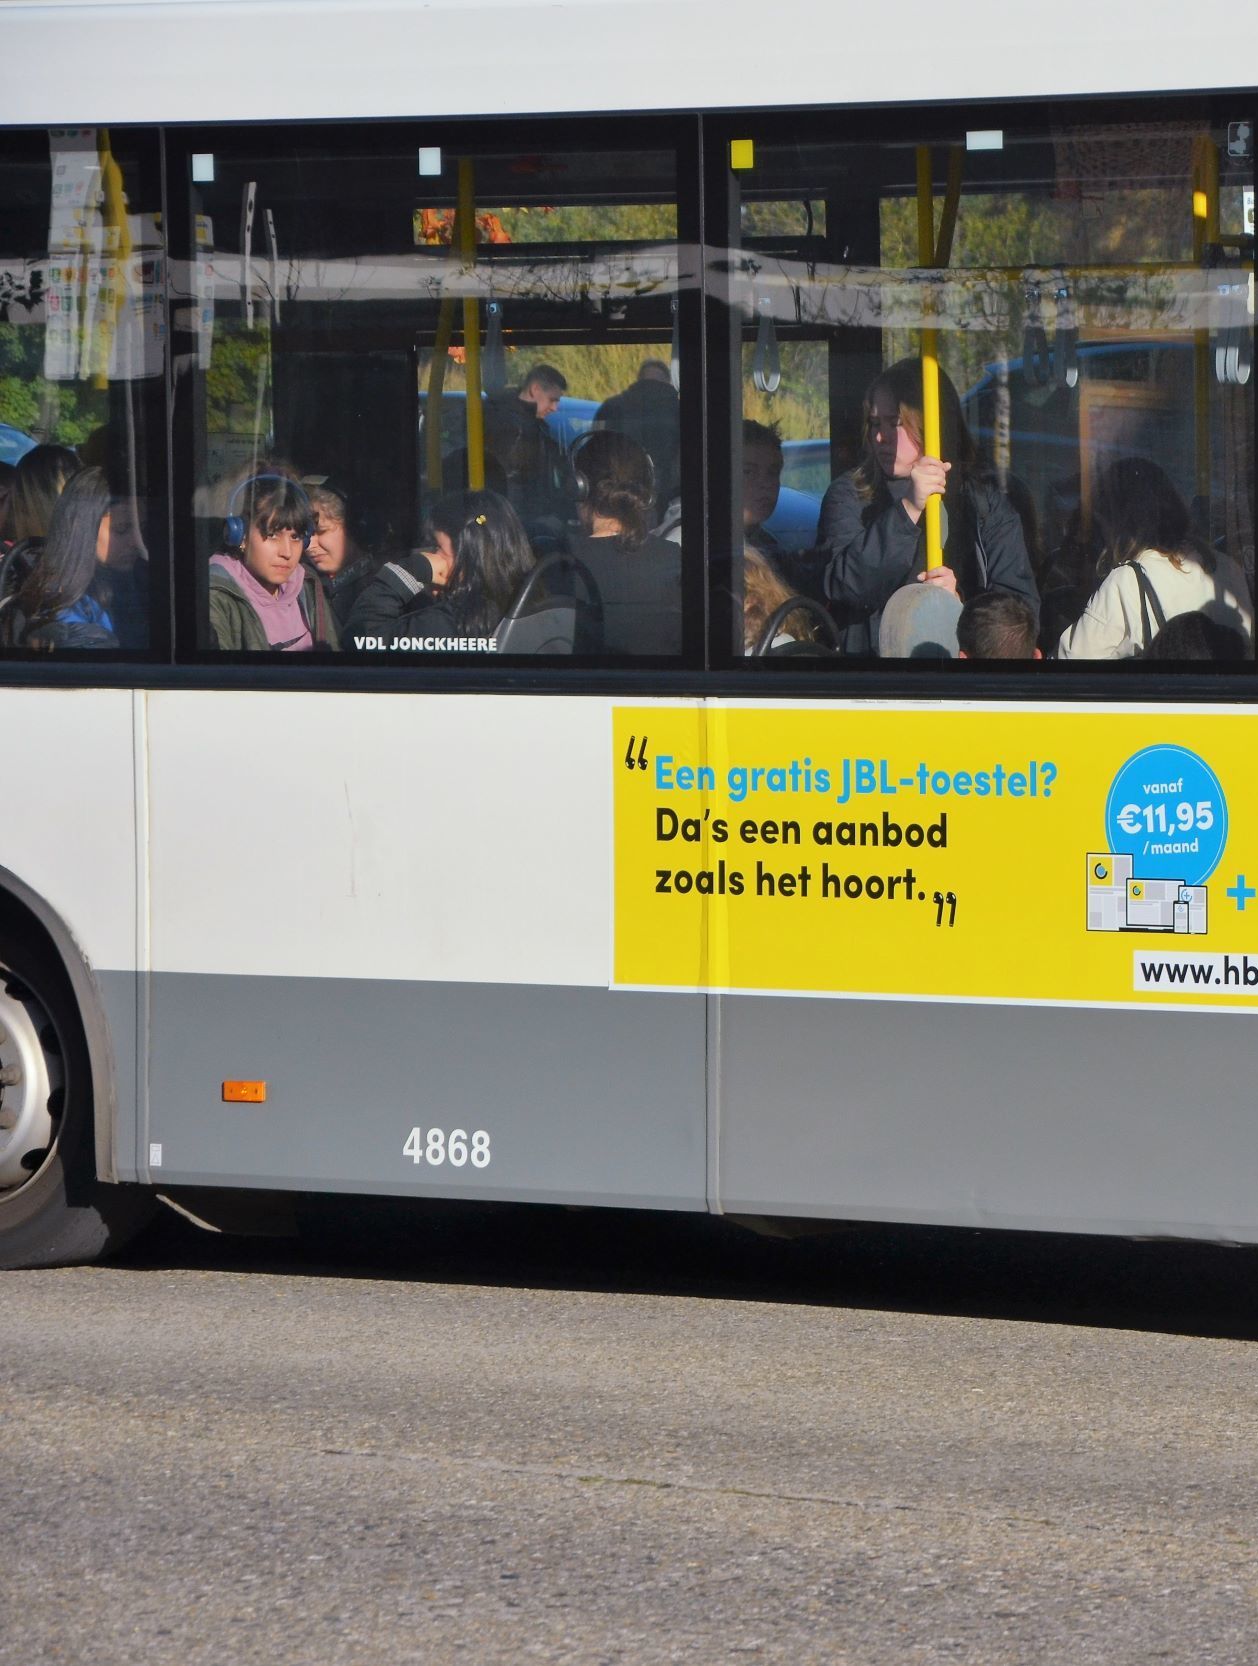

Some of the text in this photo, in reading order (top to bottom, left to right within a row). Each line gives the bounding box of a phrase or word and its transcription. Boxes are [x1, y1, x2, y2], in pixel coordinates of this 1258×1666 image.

[353, 636, 498, 652] VDL JONCKHEERE
[655, 755, 1058, 804] Een gratis JBL-toestel?
[1142, 777, 1184, 795] vanaf
[655, 807, 948, 848] Da's een aanbod
[1116, 801, 1215, 837] €11,95
[655, 860, 926, 901] zoals het hoort.
[402, 1127, 491, 1169] 4868
